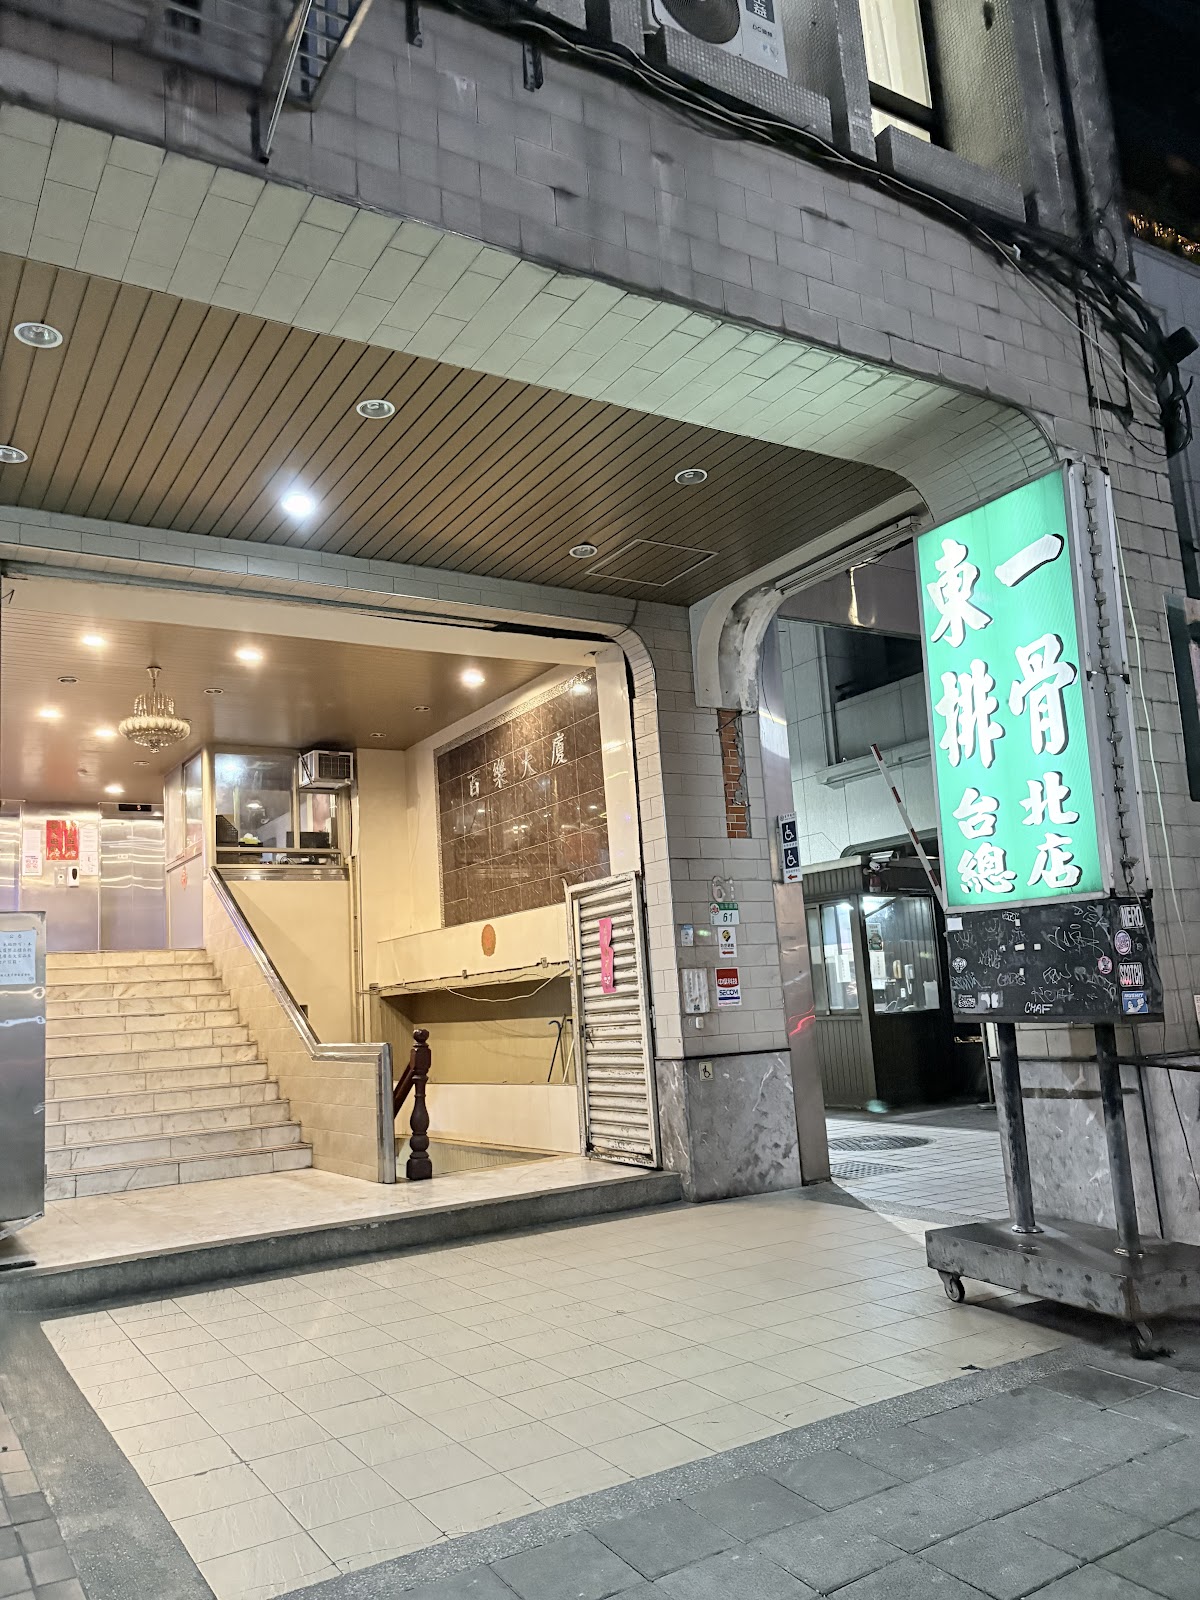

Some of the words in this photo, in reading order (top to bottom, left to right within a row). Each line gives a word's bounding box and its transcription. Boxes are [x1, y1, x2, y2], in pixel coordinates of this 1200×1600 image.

[467, 732, 567, 797] 百樂大廈
[723, 913, 732, 922] 61
